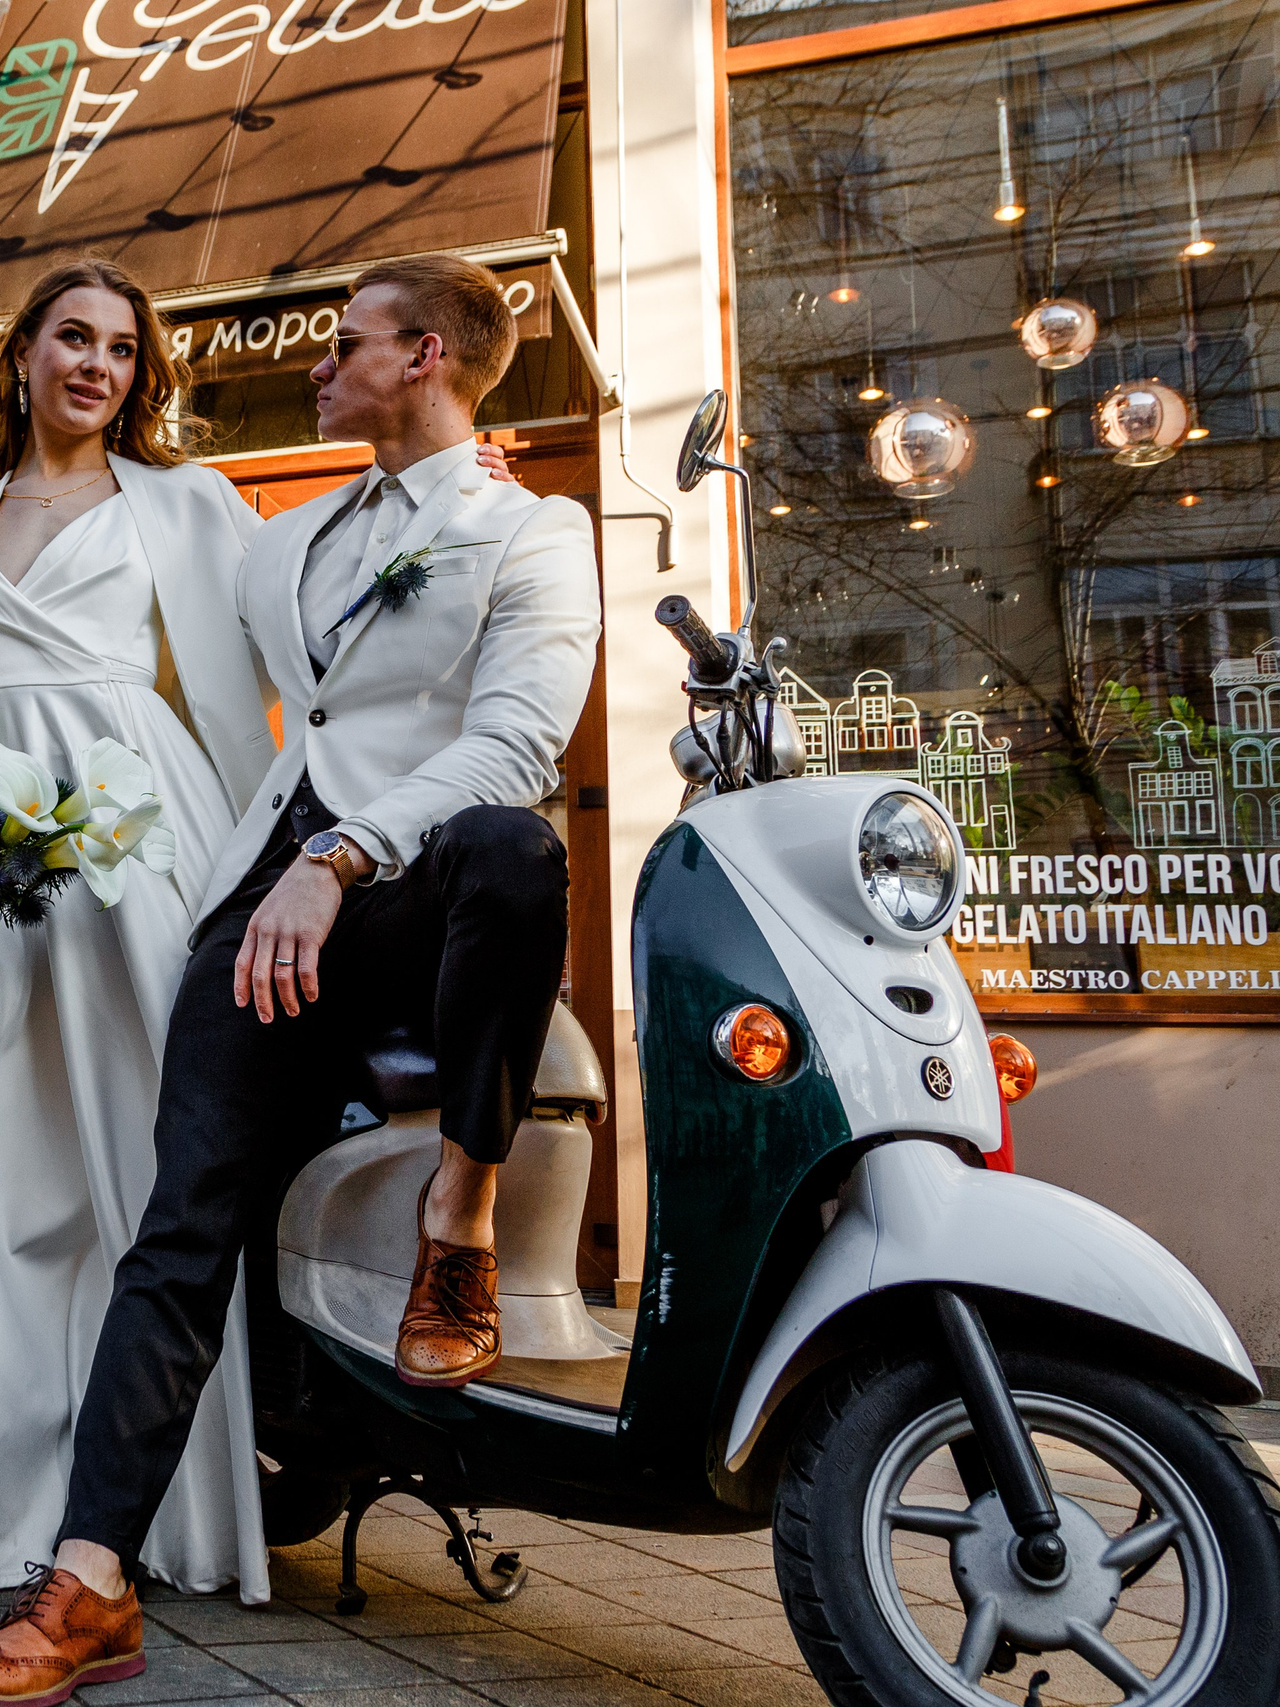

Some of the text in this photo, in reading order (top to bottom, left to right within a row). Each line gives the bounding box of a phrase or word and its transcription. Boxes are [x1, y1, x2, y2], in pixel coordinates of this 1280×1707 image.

[1009, 854, 1149, 895] FRESCO
[1158, 853, 1234, 895] PER
[952, 904, 1268, 946] GELATO ITALIANO
[981, 968, 1130, 990] MAESTRO
